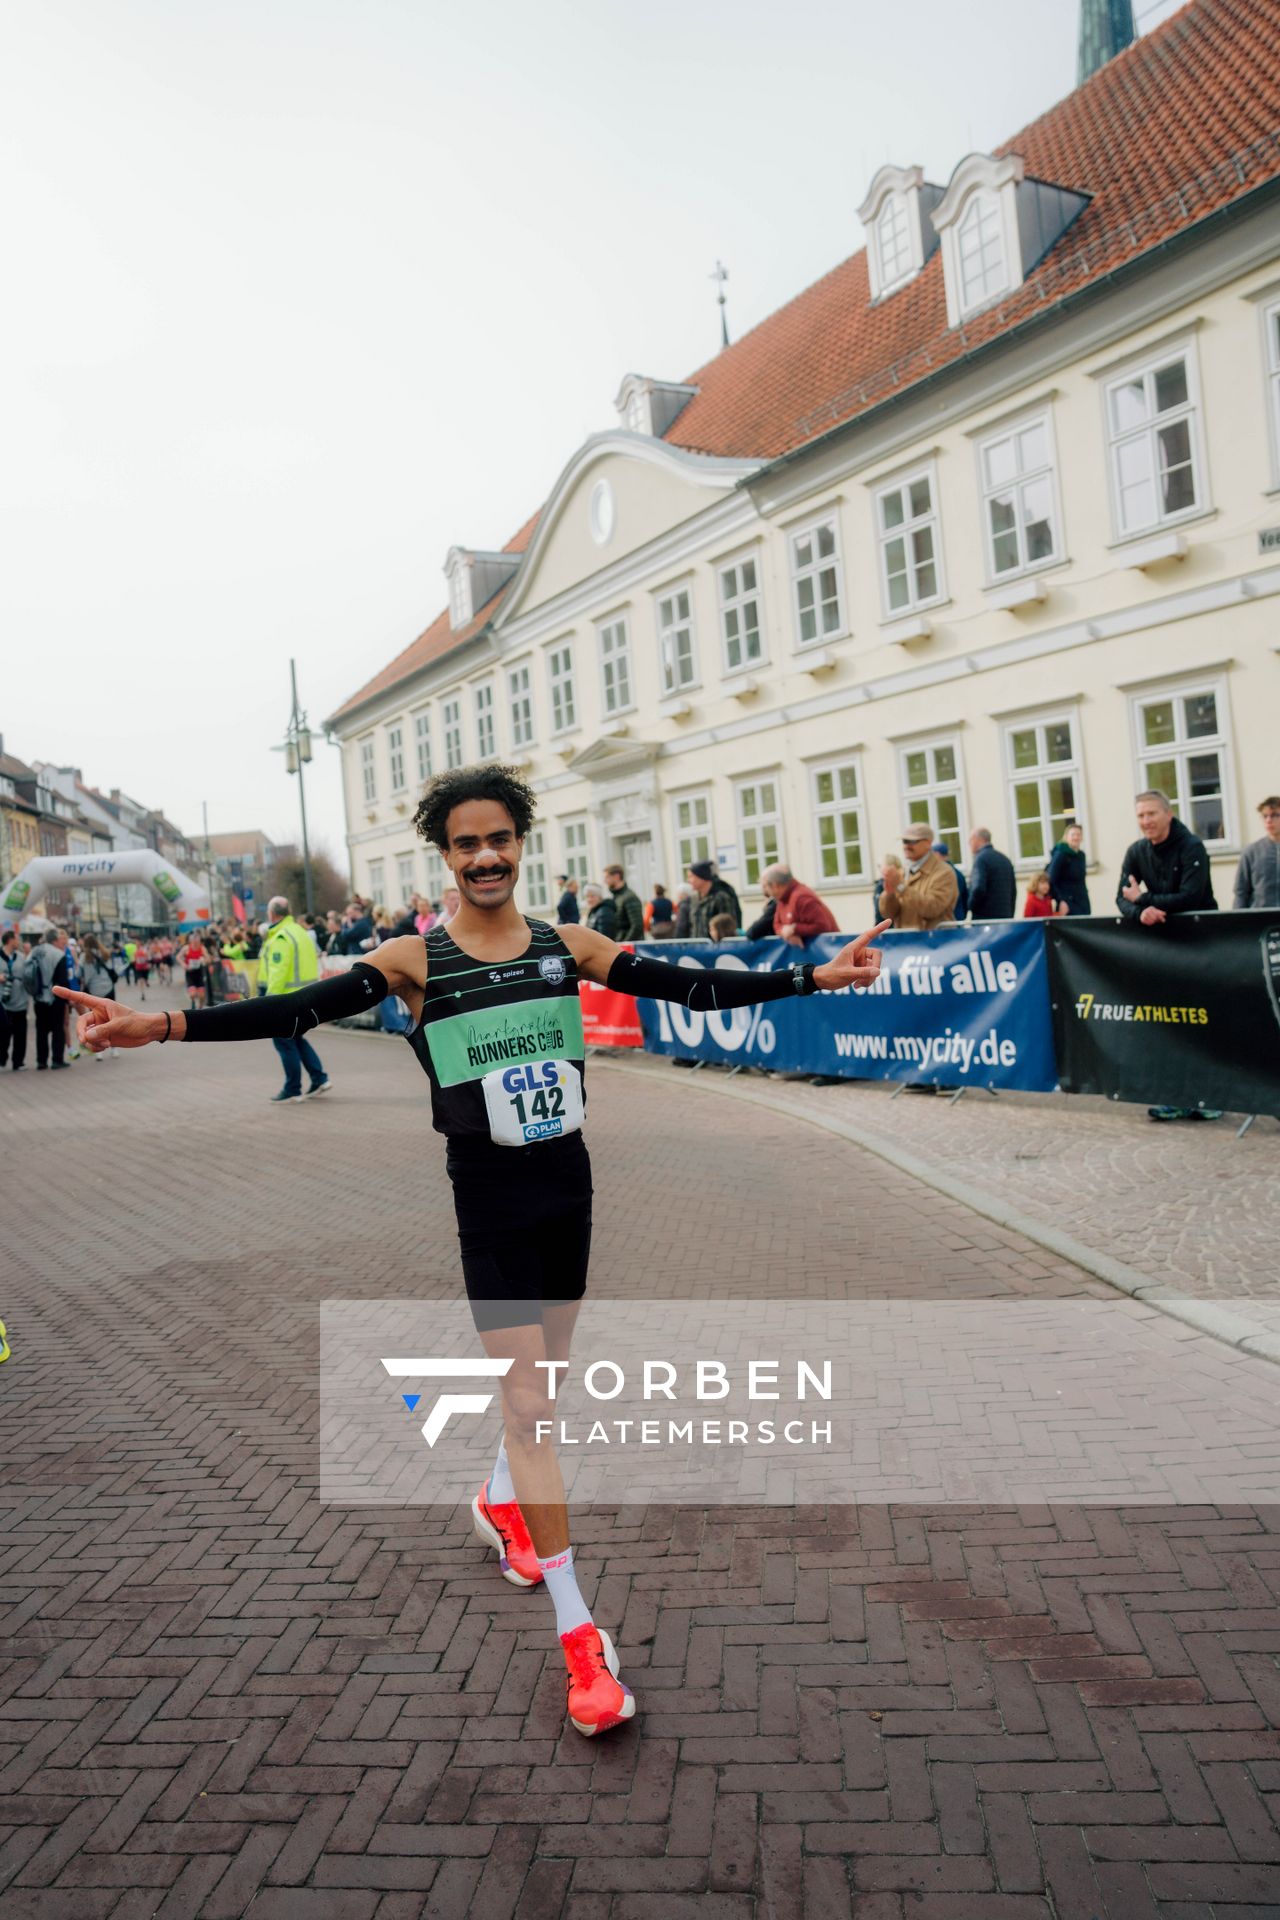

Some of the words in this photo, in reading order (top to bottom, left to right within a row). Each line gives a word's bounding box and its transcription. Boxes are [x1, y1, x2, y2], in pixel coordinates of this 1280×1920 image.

[62, 860, 117, 875] mycity
[502, 968, 525, 979] spized
[898, 955, 945, 996] für
[950, 950, 1018, 994] alle
[467, 1034, 537, 1067] RUNNERS
[834, 1028, 1017, 1075] www.mycity.de
[509, 1086, 566, 1125] 142
[540, 1121, 561, 1133] PLAN
